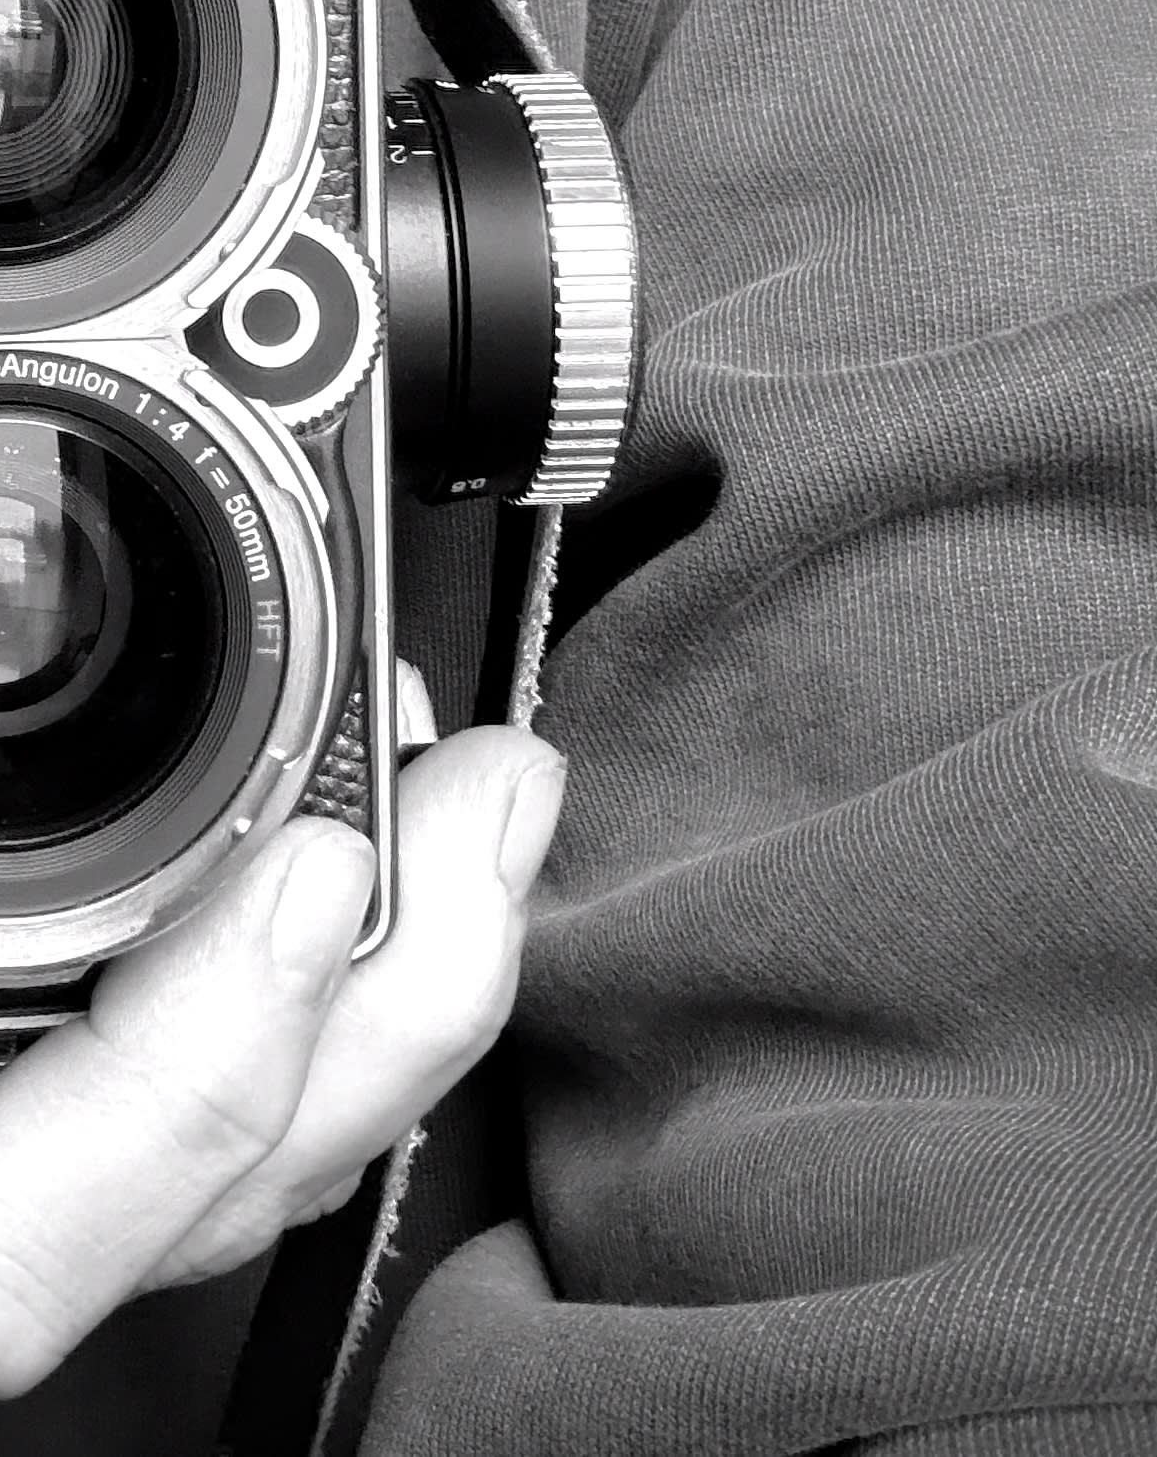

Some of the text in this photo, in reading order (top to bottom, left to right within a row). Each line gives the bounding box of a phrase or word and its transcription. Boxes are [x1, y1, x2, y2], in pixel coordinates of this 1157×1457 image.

[194, 446, 219, 465] f
[225, 492, 273, 583] 50mm
[256, 599, 282, 663] HFT
